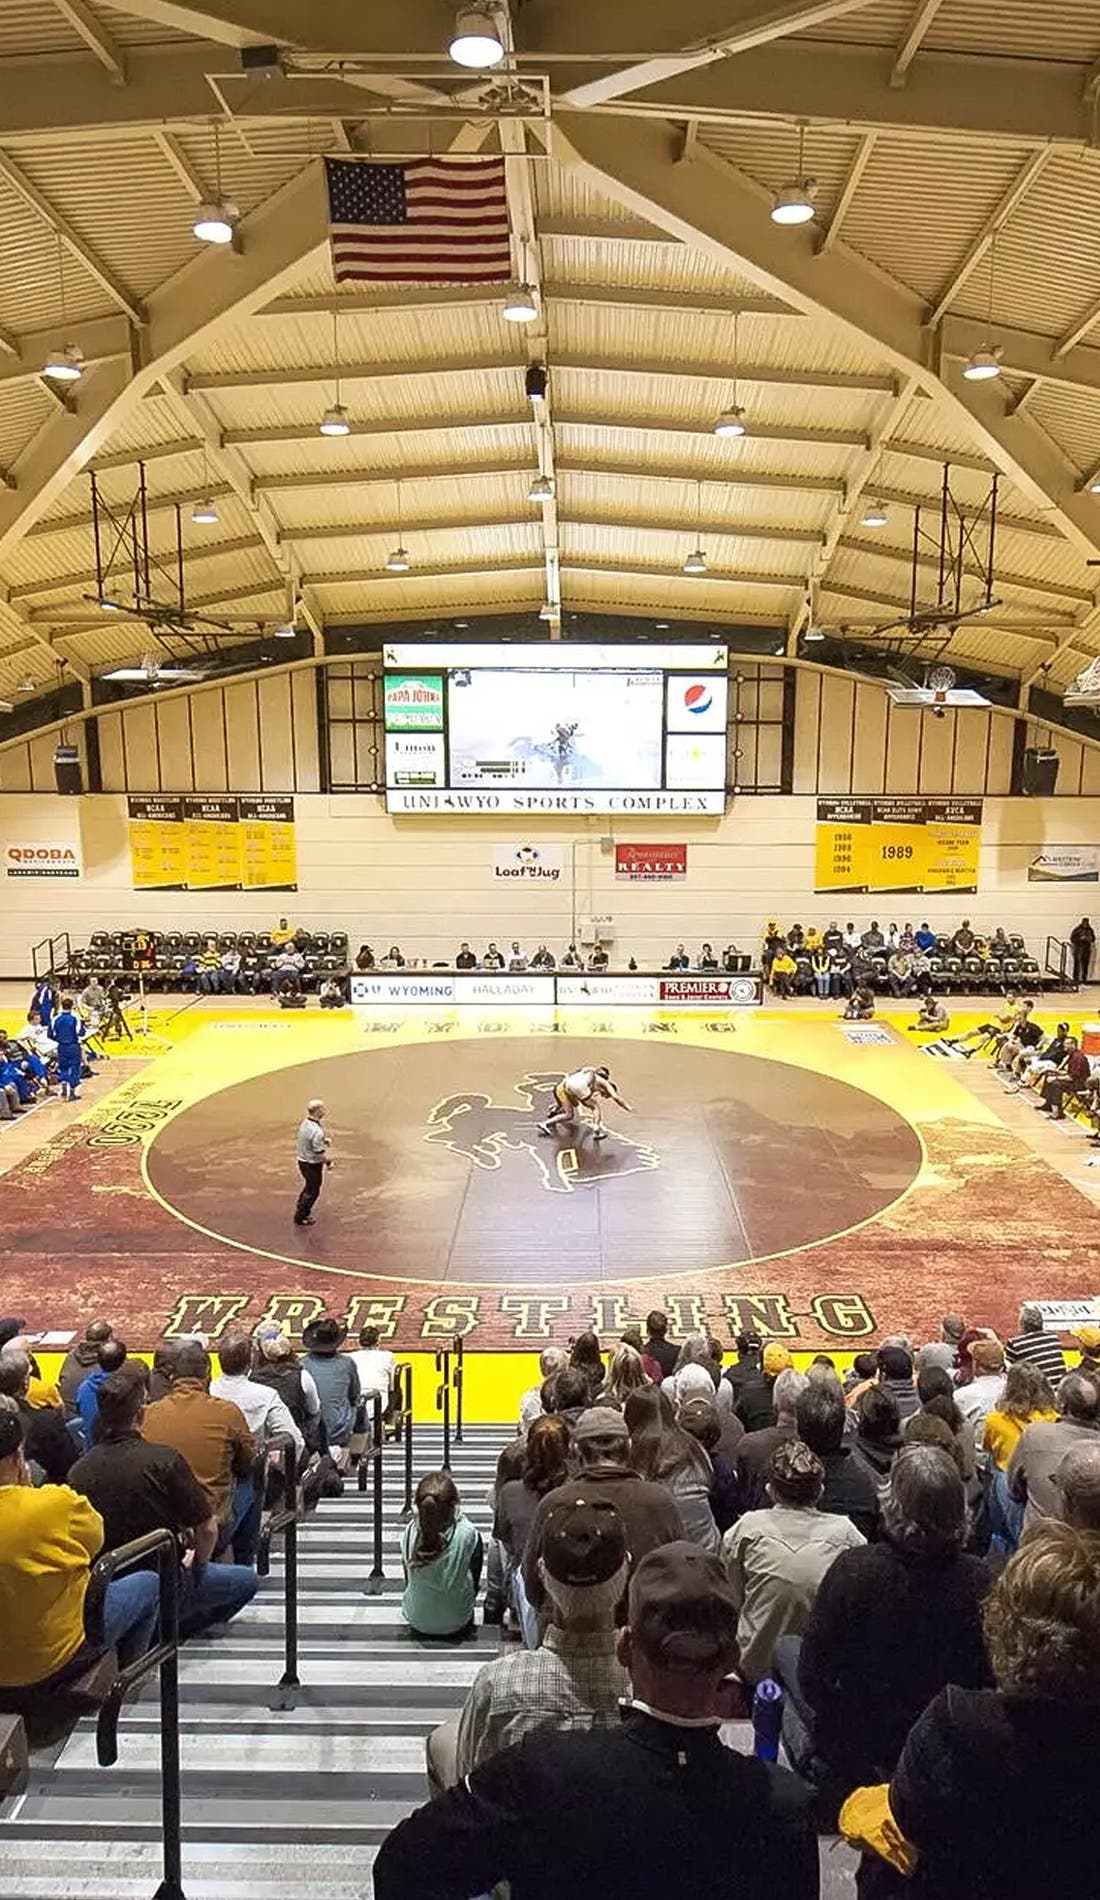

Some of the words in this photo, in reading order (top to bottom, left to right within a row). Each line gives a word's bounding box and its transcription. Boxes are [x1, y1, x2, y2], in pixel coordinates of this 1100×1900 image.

[513, 796, 595, 809] SPORTS
[608, 797, 708, 810] COMPLEX
[8, 849, 76, 862] QDOBA
[882, 845, 914, 860] 1989
[495, 866, 526, 877] Loaf
[537, 866, 560, 880] Jug
[618, 862, 686, 872] REALTY
[388, 985, 453, 997] WYOMING
[665, 982, 718, 993] PREMIER
[163, 1294, 878, 1338] WRESTLING
